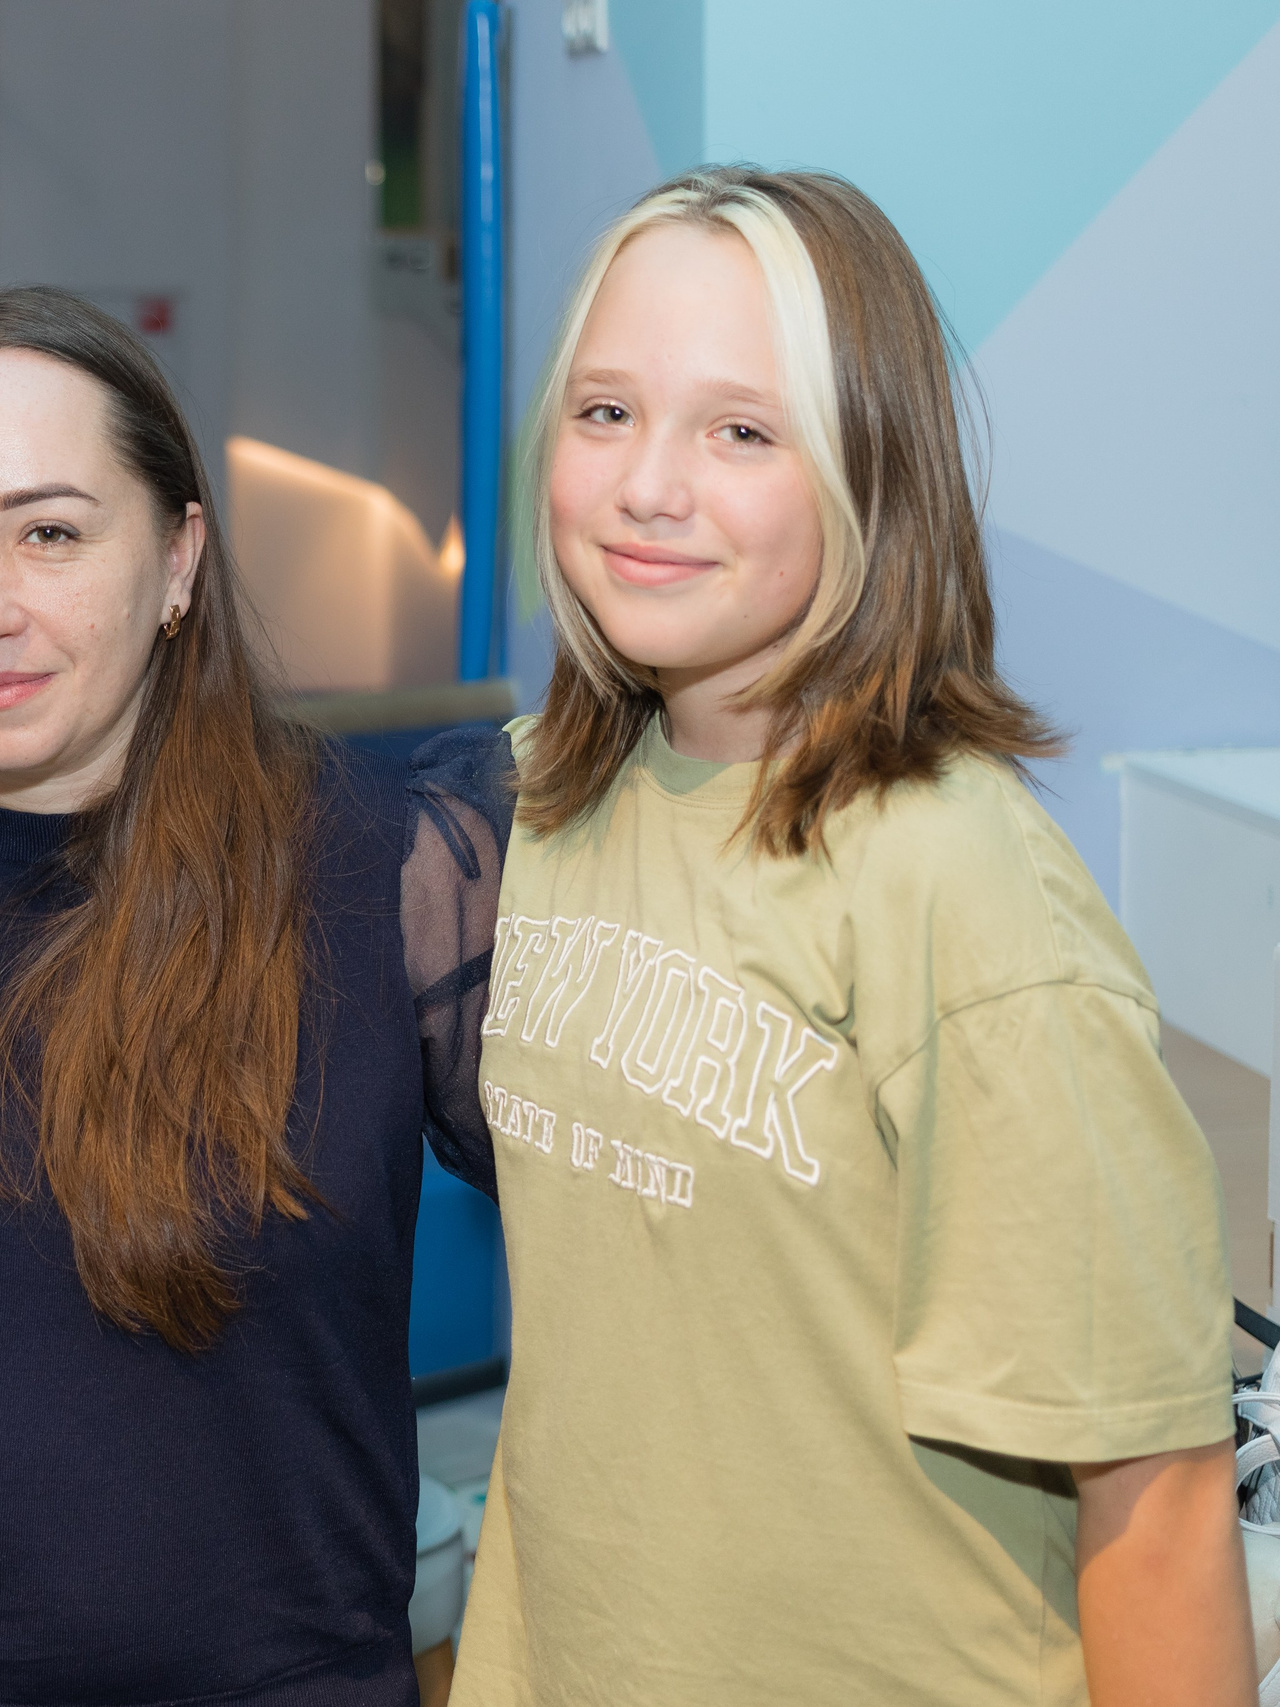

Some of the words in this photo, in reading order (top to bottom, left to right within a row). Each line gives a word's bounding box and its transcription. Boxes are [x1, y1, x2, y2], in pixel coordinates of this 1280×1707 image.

[484, 1081, 556, 1154] STATE
[571, 1122, 603, 1171] OF
[608, 1139, 694, 1208] MIND
[589, 929, 838, 1185] YORK
